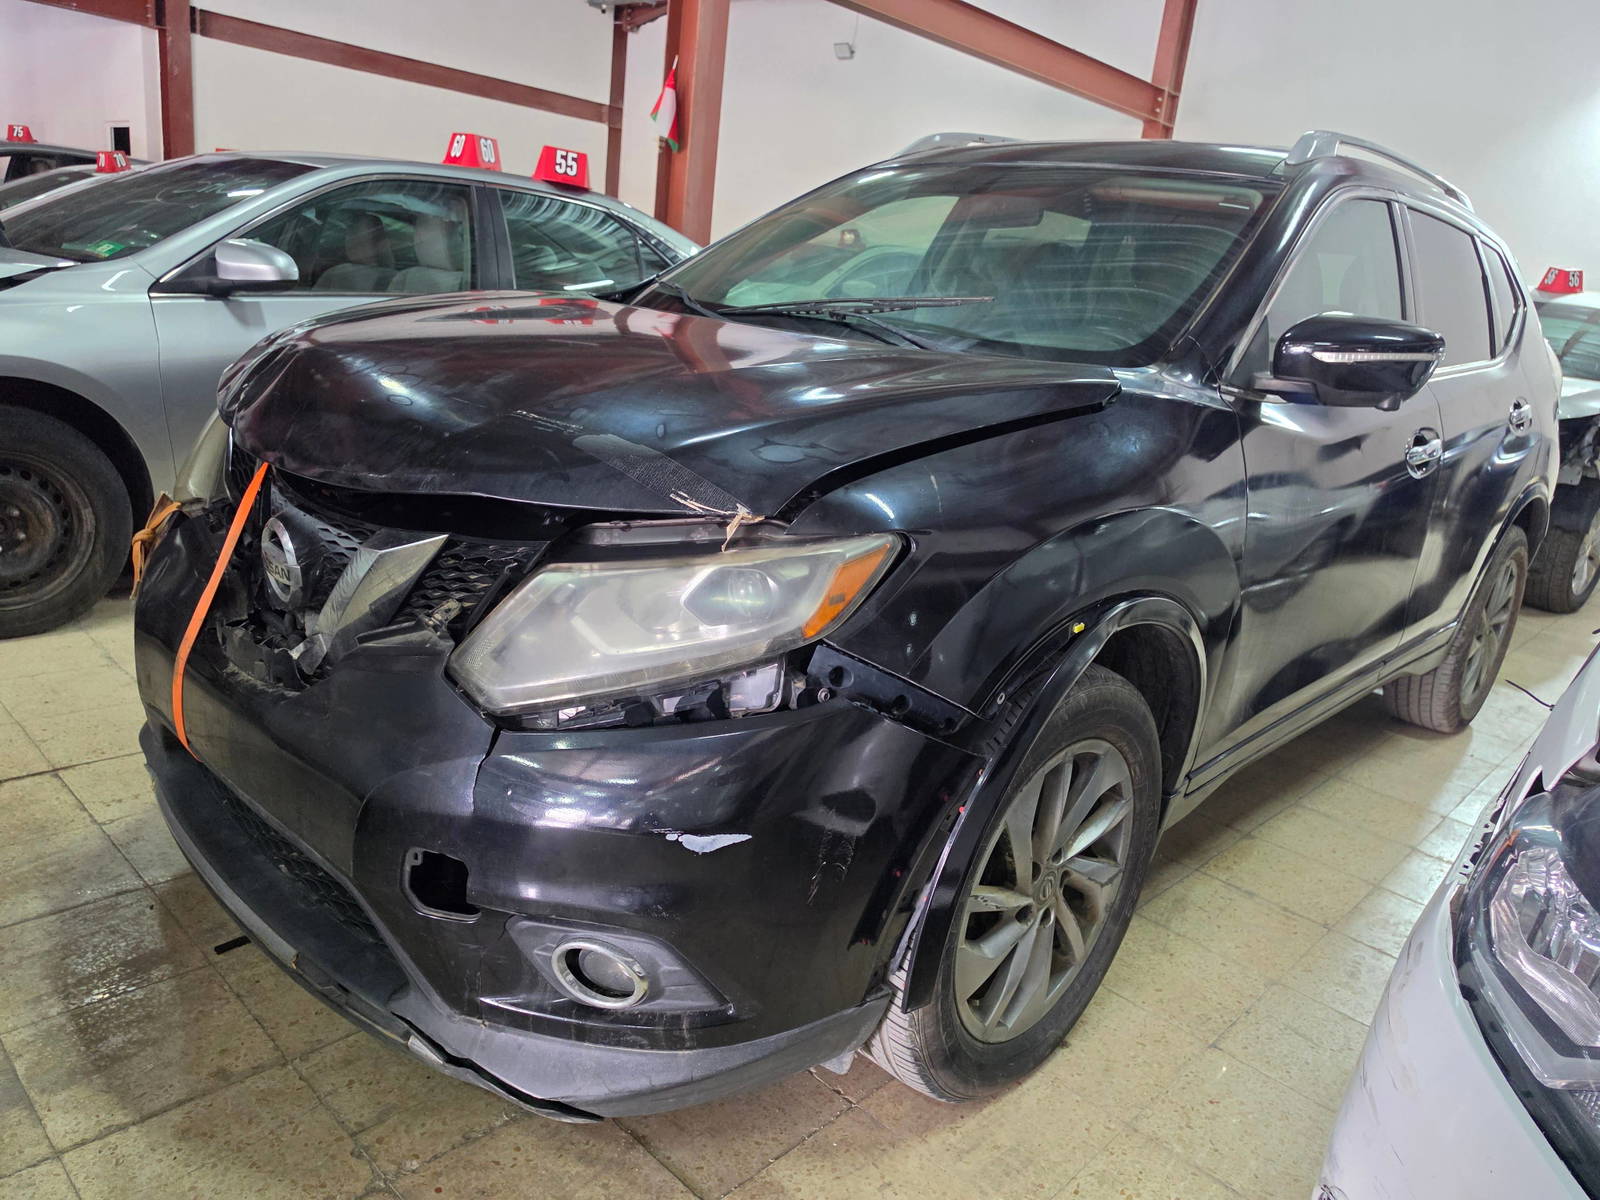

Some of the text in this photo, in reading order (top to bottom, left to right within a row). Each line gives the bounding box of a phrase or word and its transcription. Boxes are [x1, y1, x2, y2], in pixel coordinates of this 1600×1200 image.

[13, 126, 24, 138] 75
[450, 134, 466, 158] 60
[479, 137, 496, 164] 60
[113, 152, 127, 168] 70
[554, 149, 578, 177] 55
[1568, 271, 1580, 288] 56
